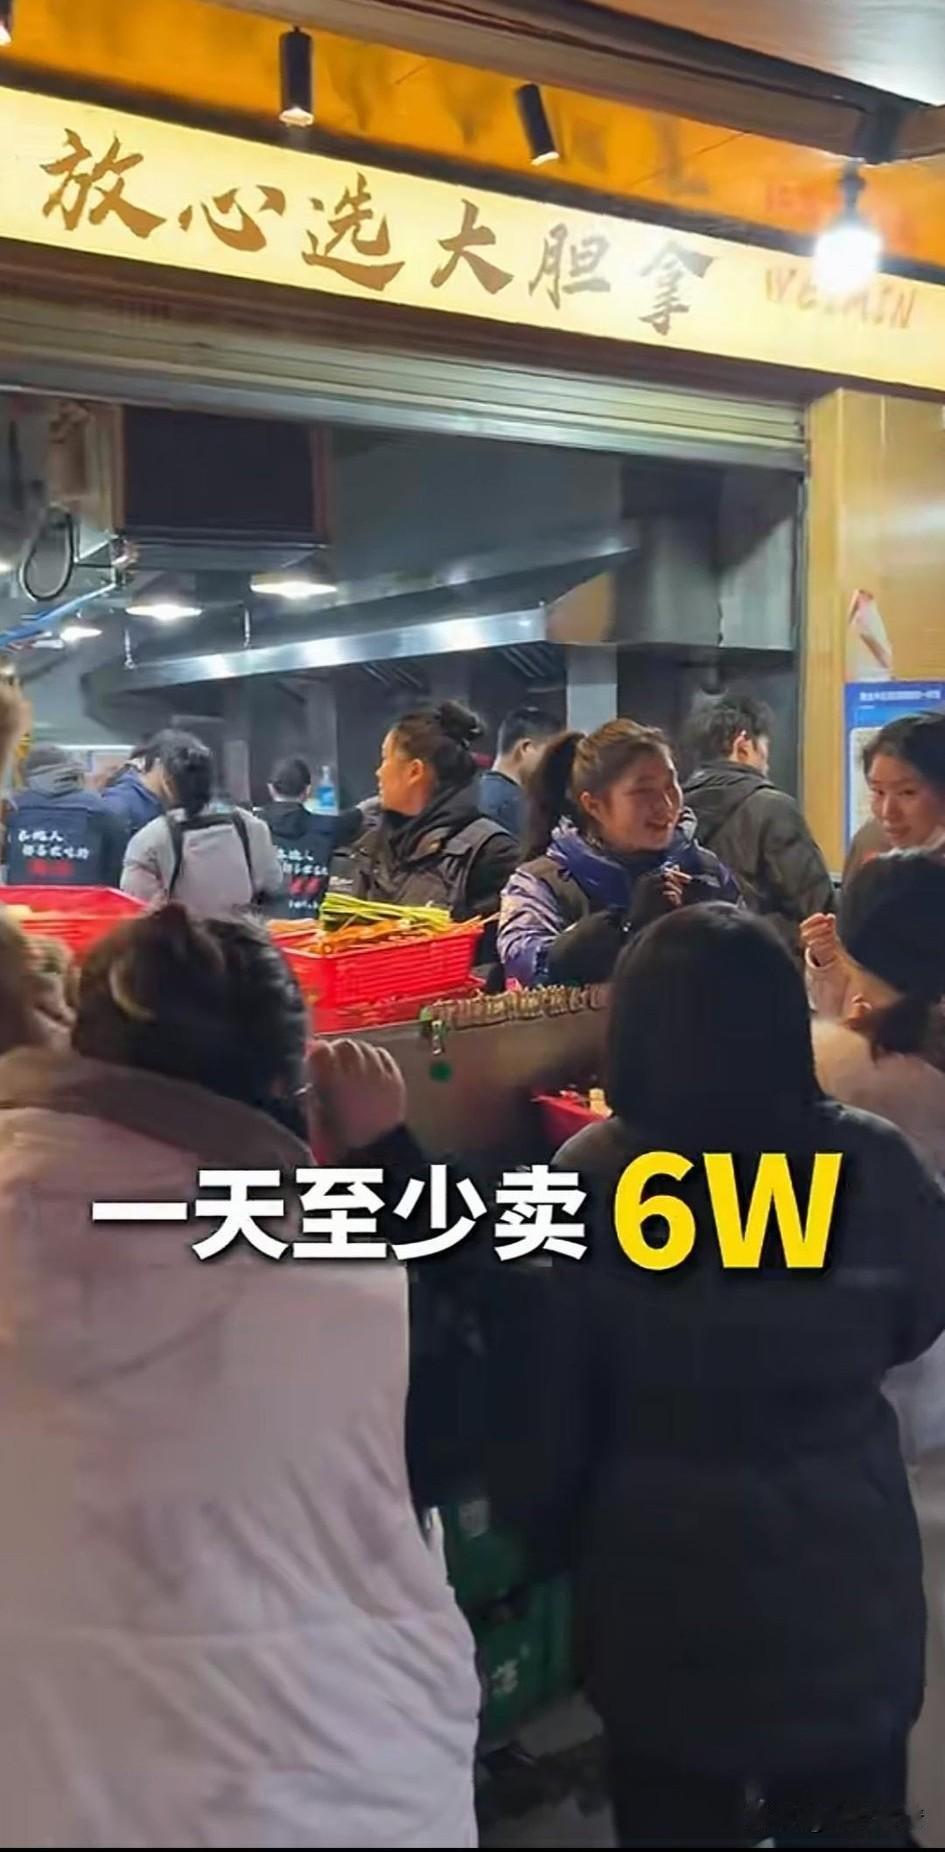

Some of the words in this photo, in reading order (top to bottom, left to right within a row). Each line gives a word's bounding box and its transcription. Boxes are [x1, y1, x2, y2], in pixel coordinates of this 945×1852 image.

[40, 128, 714, 335] 放心选大胆拿
